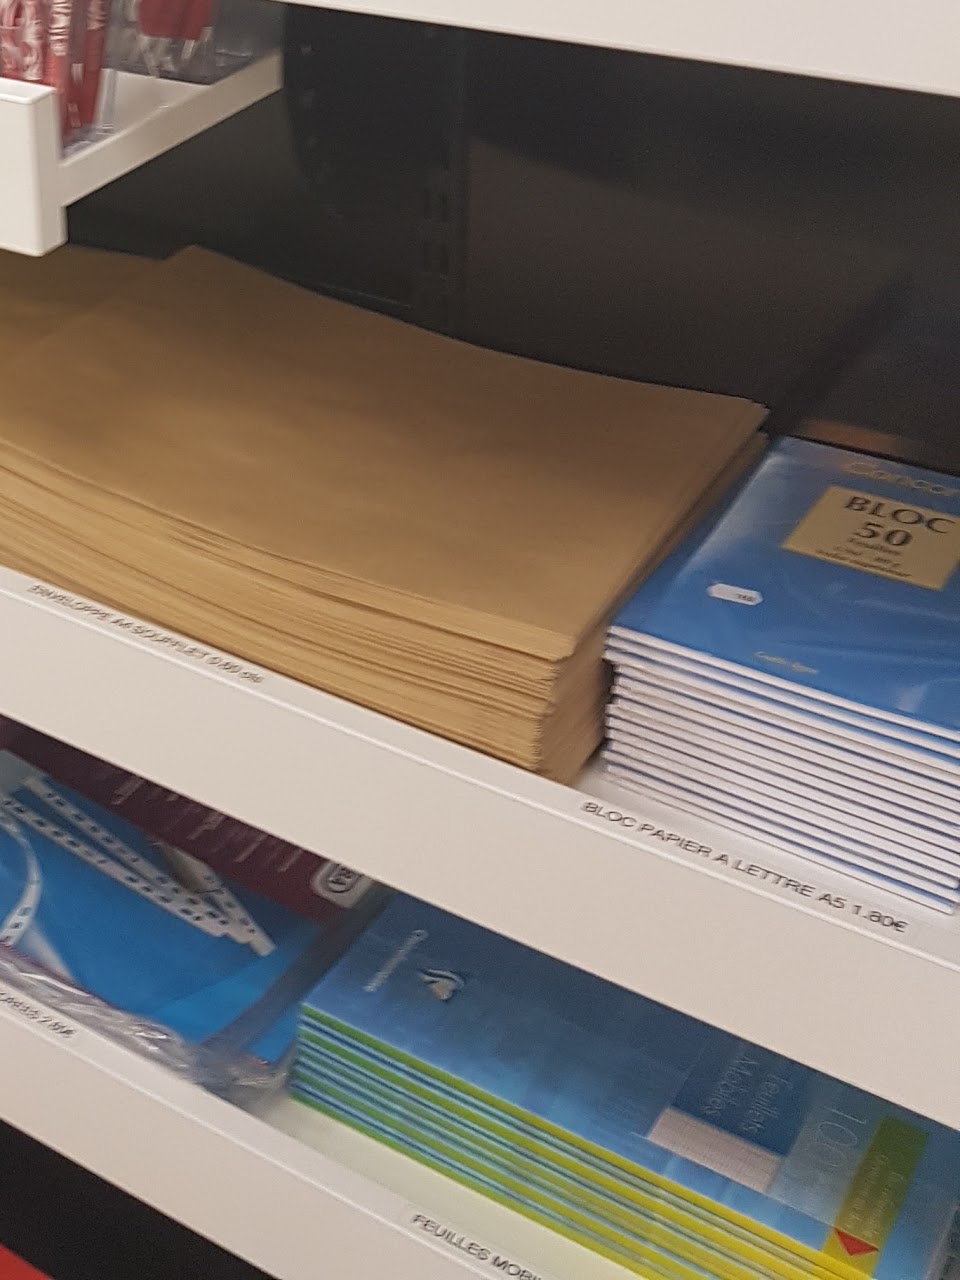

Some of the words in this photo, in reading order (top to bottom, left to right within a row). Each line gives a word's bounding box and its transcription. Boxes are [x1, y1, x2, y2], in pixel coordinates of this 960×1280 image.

[844, 496, 957, 534] BLOC
[852, 521, 914, 547] 50
[582, 801, 637, 828] BLOC
[639, 822, 713, 859] PAPIER
[713, 852, 731, 866] A
[732, 858, 818, 898] LETTRE
[818, 892, 848, 910] A5
[852, 903, 911, 933] 1.80€
[412, 1213, 491, 1261] FEUILLES
